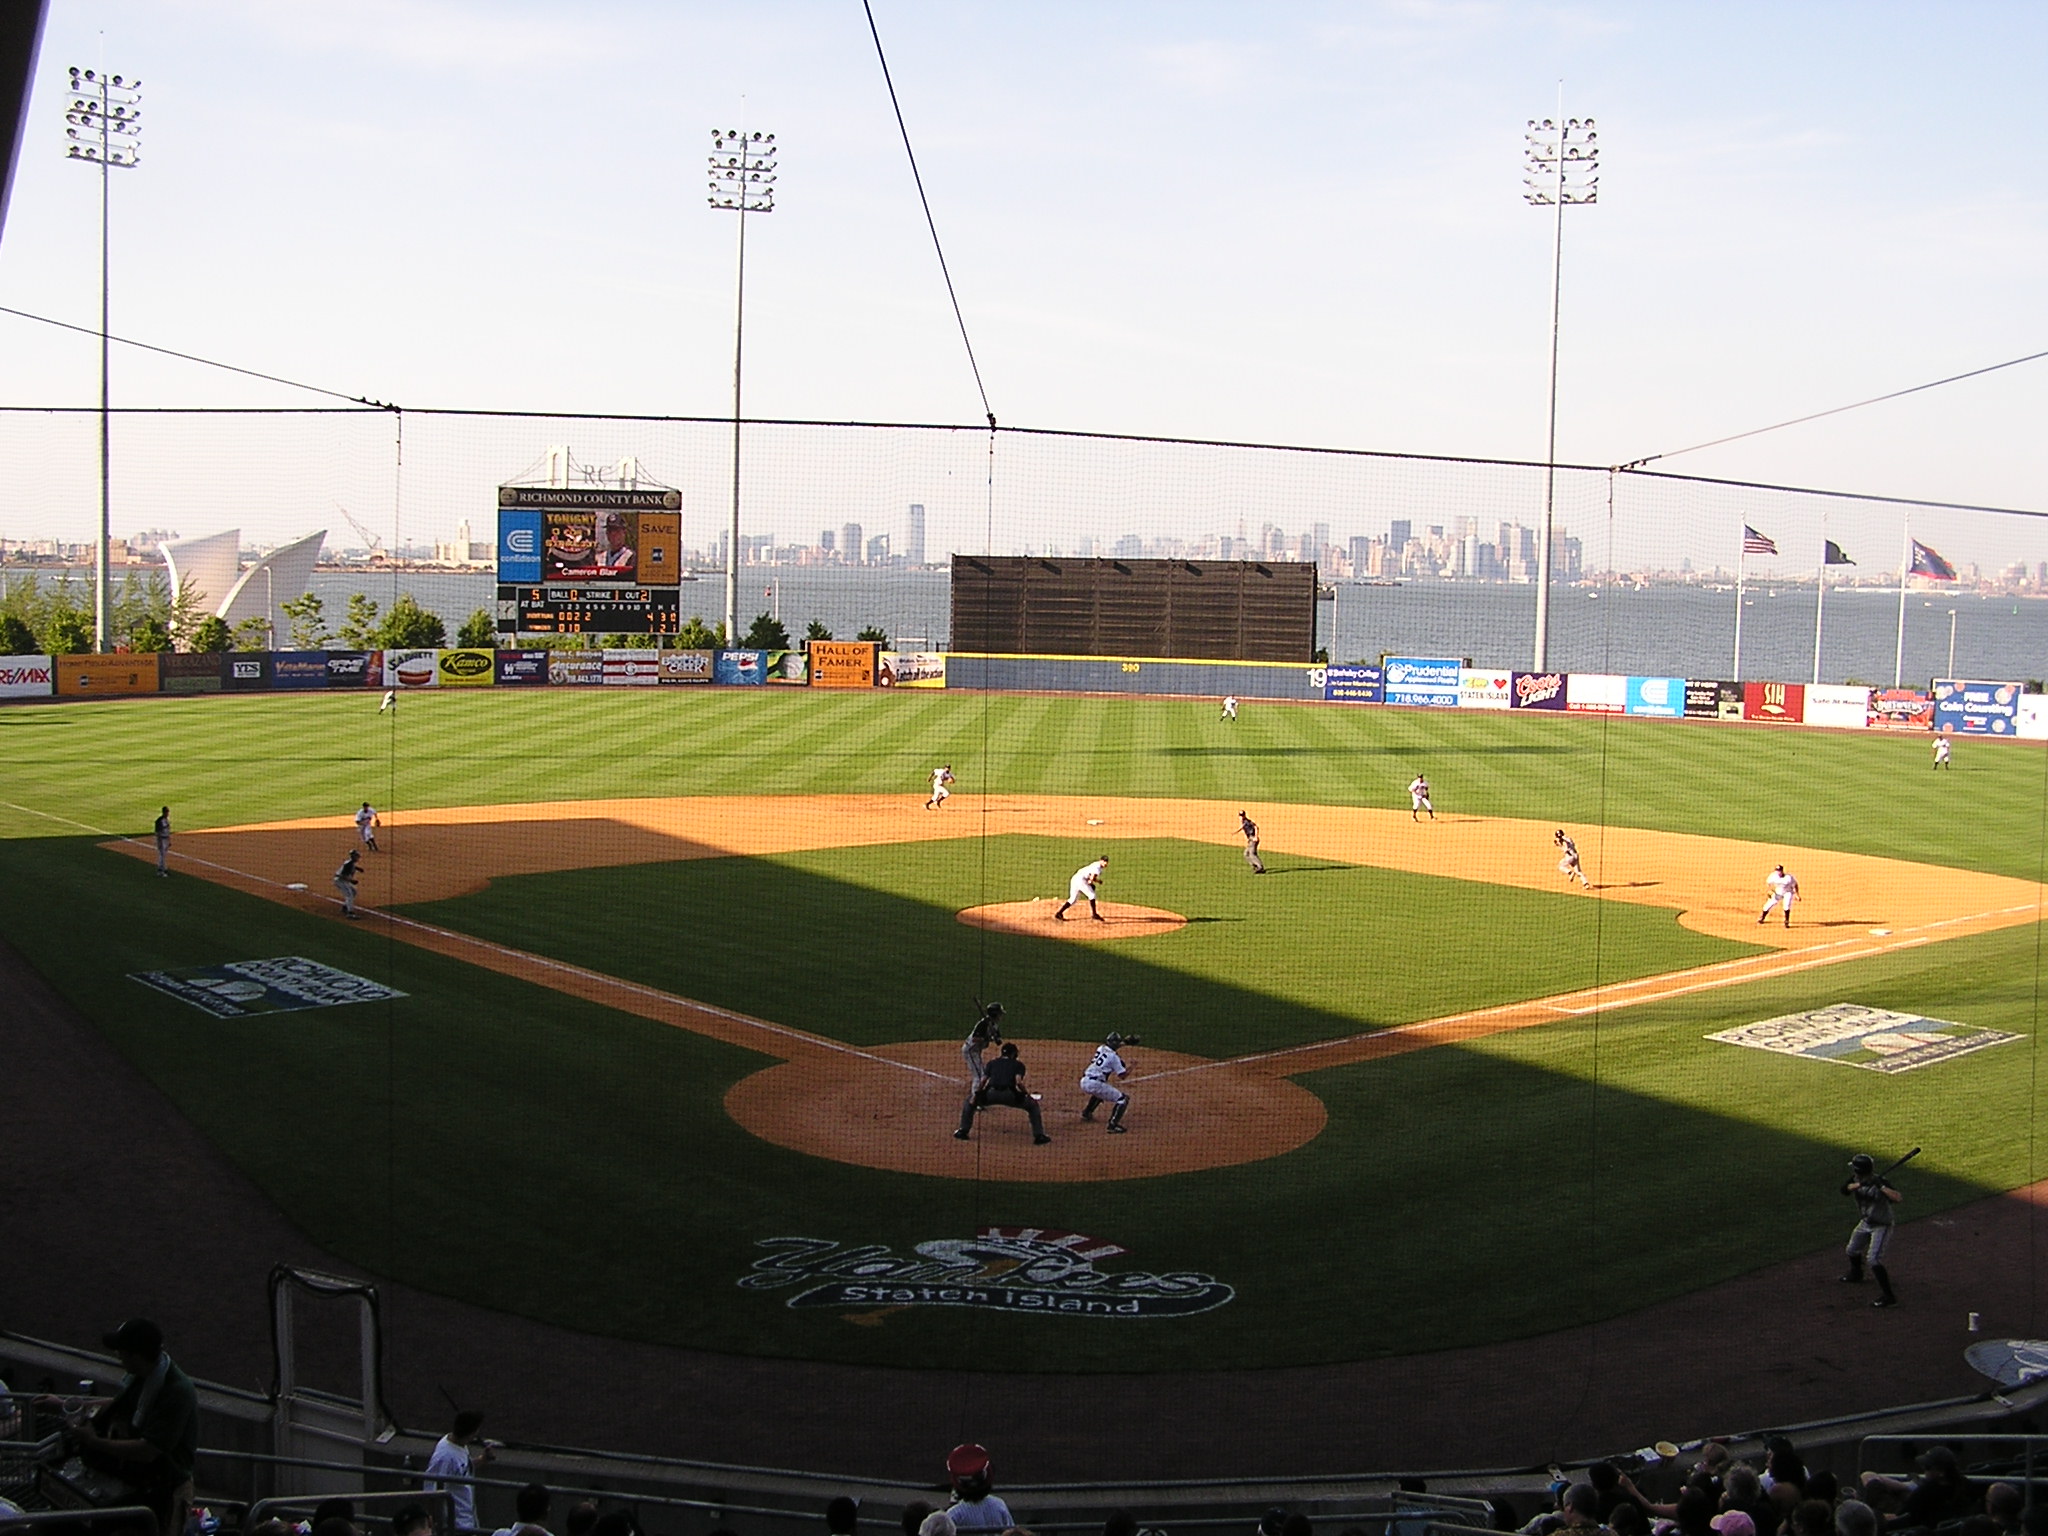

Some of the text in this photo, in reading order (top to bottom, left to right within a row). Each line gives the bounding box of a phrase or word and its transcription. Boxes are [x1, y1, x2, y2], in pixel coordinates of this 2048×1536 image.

[519, 493, 663, 505] RICHMOND COUNTY BANK
[501, 555, 541, 563] conEdison
[561, 568, 618, 576] Cameron Blair
[551, 590, 648, 601] BALL 0 STRIKE 1 OUT 2
[722, 652, 759, 661] PEPSI
[816, 646, 869, 655] HALL OF
[236, 663, 259, 672] YES
[445, 653, 488, 670] Kamco
[0, 667, 50, 684] RE/MAX
[1404, 663, 1459, 677] Prudential
[1515, 673, 1562, 697] Coors
[1460, 690, 1509, 701] STATEN ISLAND
[1520, 687, 1560, 708] LIGHT
[1963, 691, 1990, 703] FREE
[1940, 701, 1964, 713] Coin
[1964, 702, 2014, 717] Counting
[736, 1237, 1220, 1297] Yankees
[839, 1285, 1141, 1314] Staten Island
